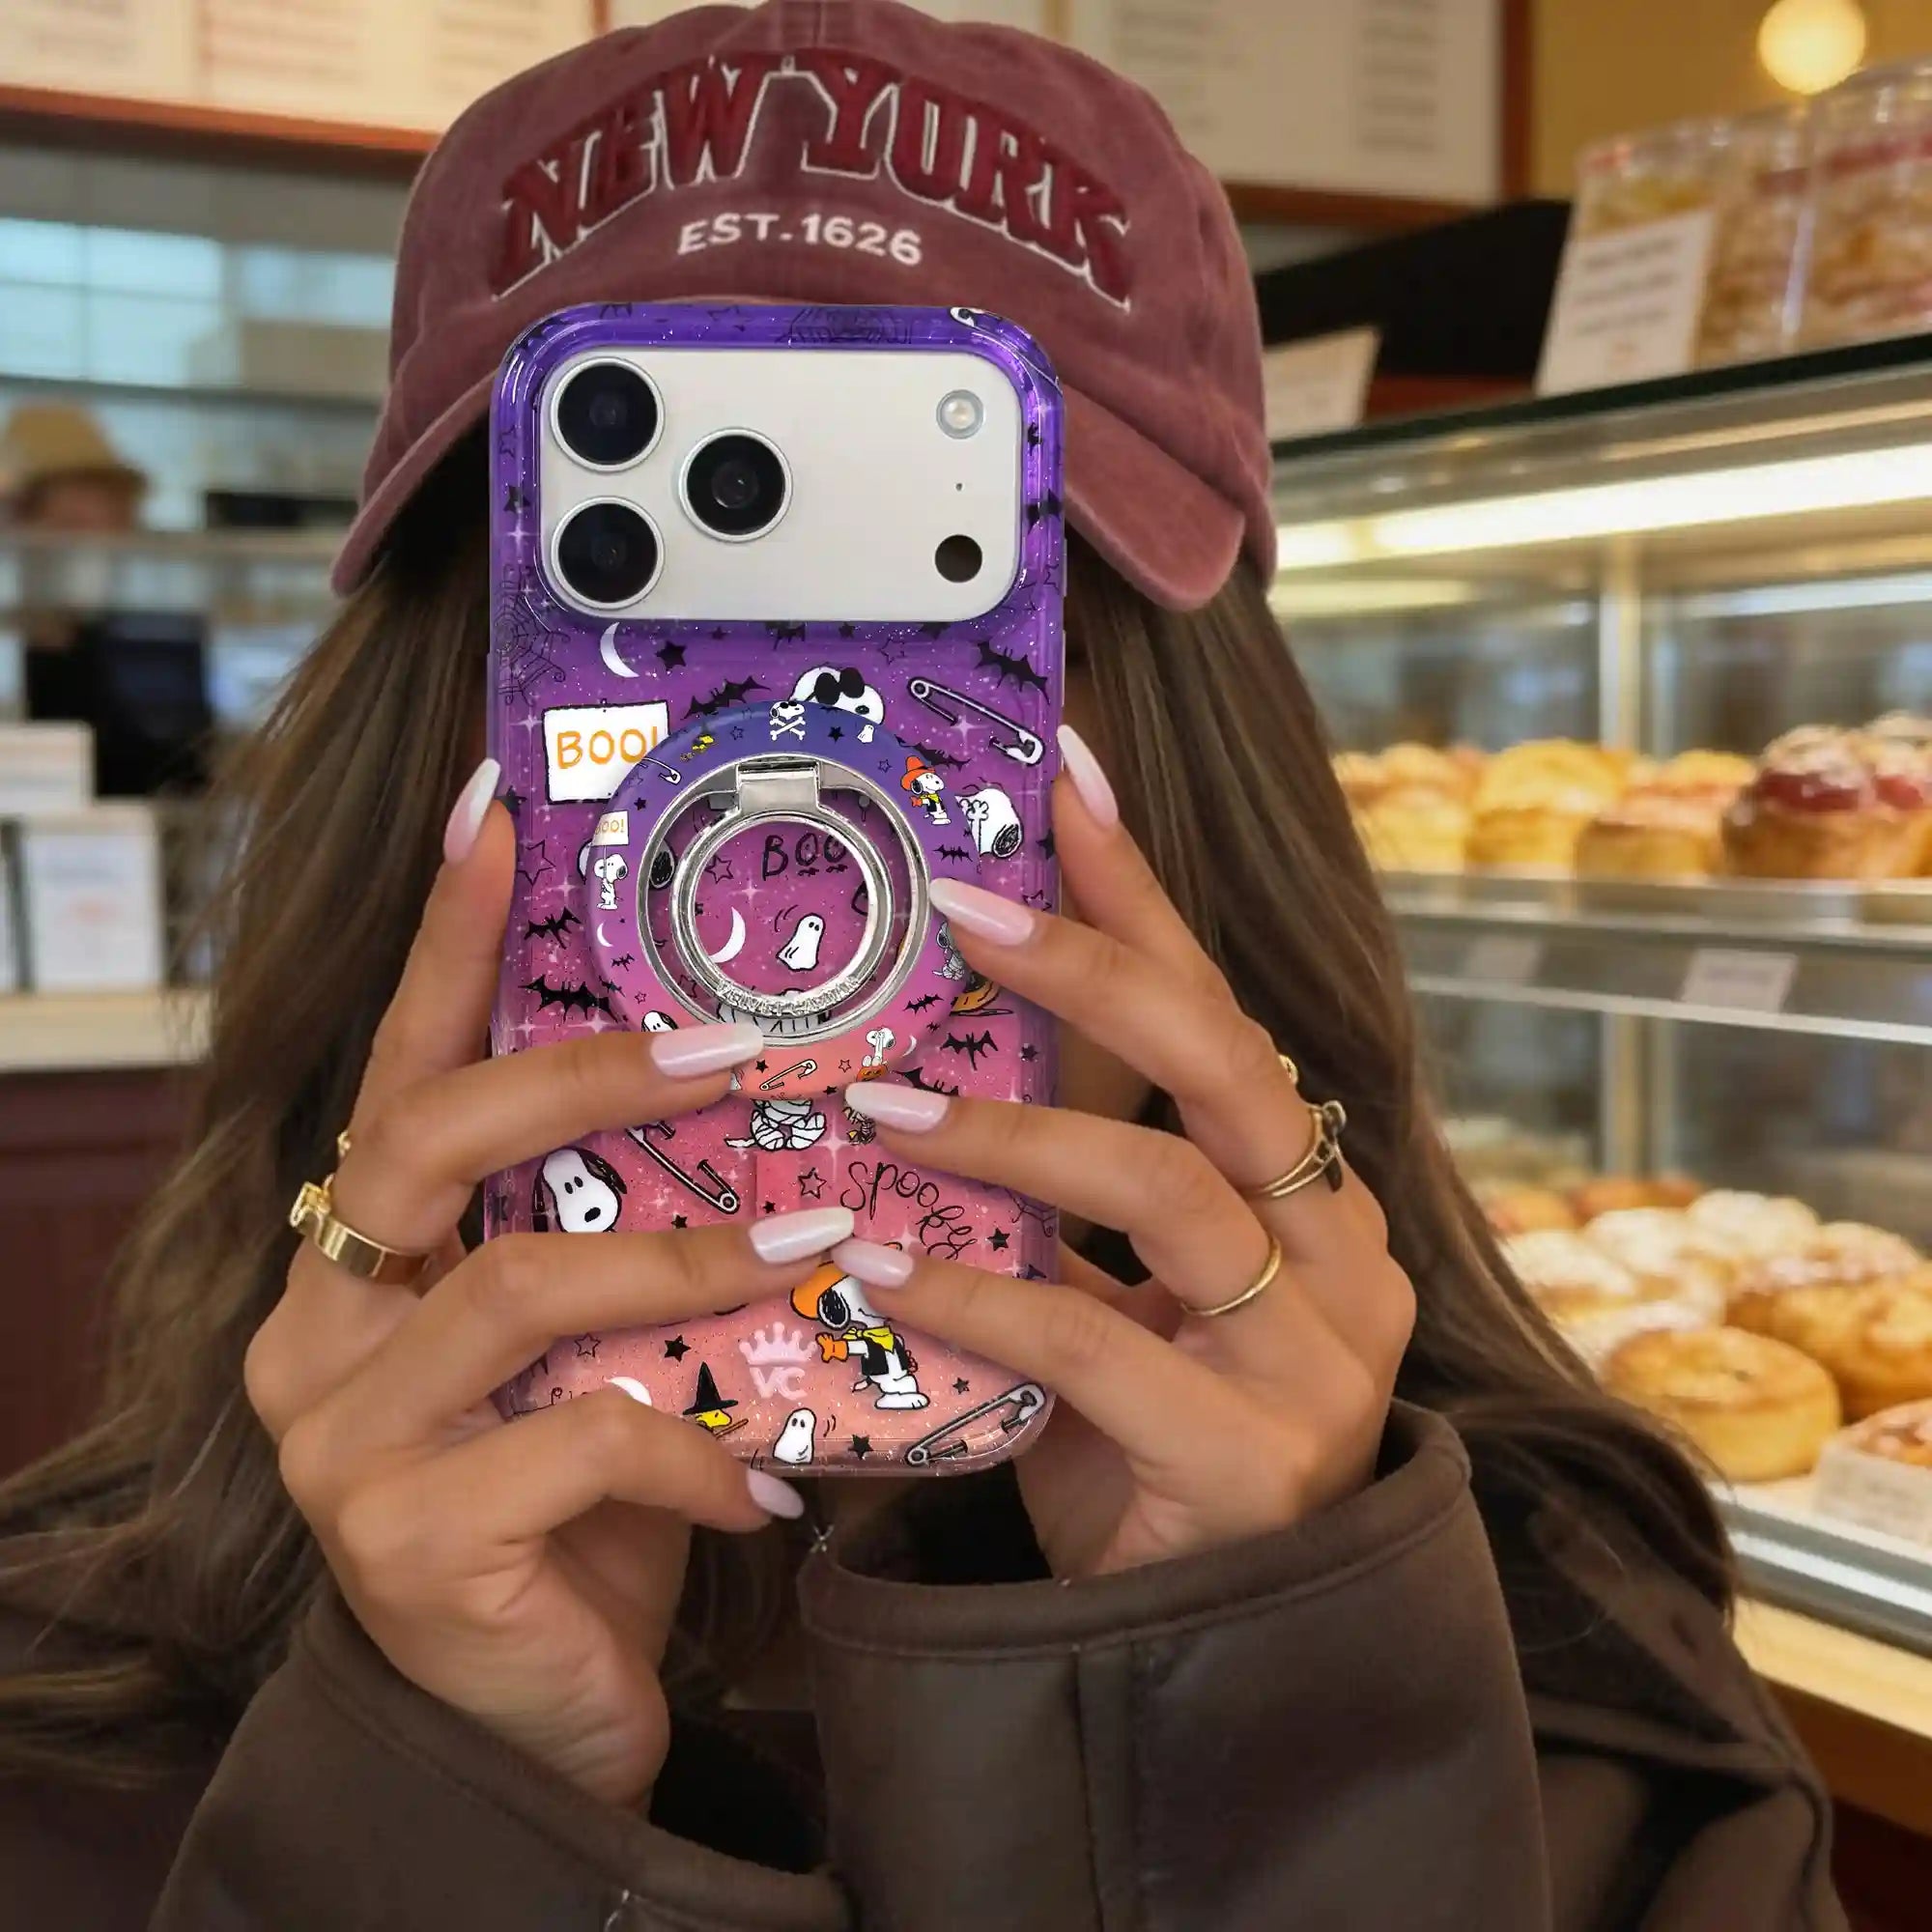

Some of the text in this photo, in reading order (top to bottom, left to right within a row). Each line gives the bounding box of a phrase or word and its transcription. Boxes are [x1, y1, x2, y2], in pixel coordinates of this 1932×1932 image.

[486, 50, 781, 301] NEW
[794, 44, 1131, 313] YORK
[556, 725, 658, 769] BOO!
[594, 818, 624, 835] OO!
[749, 1366, 808, 1401] VC
